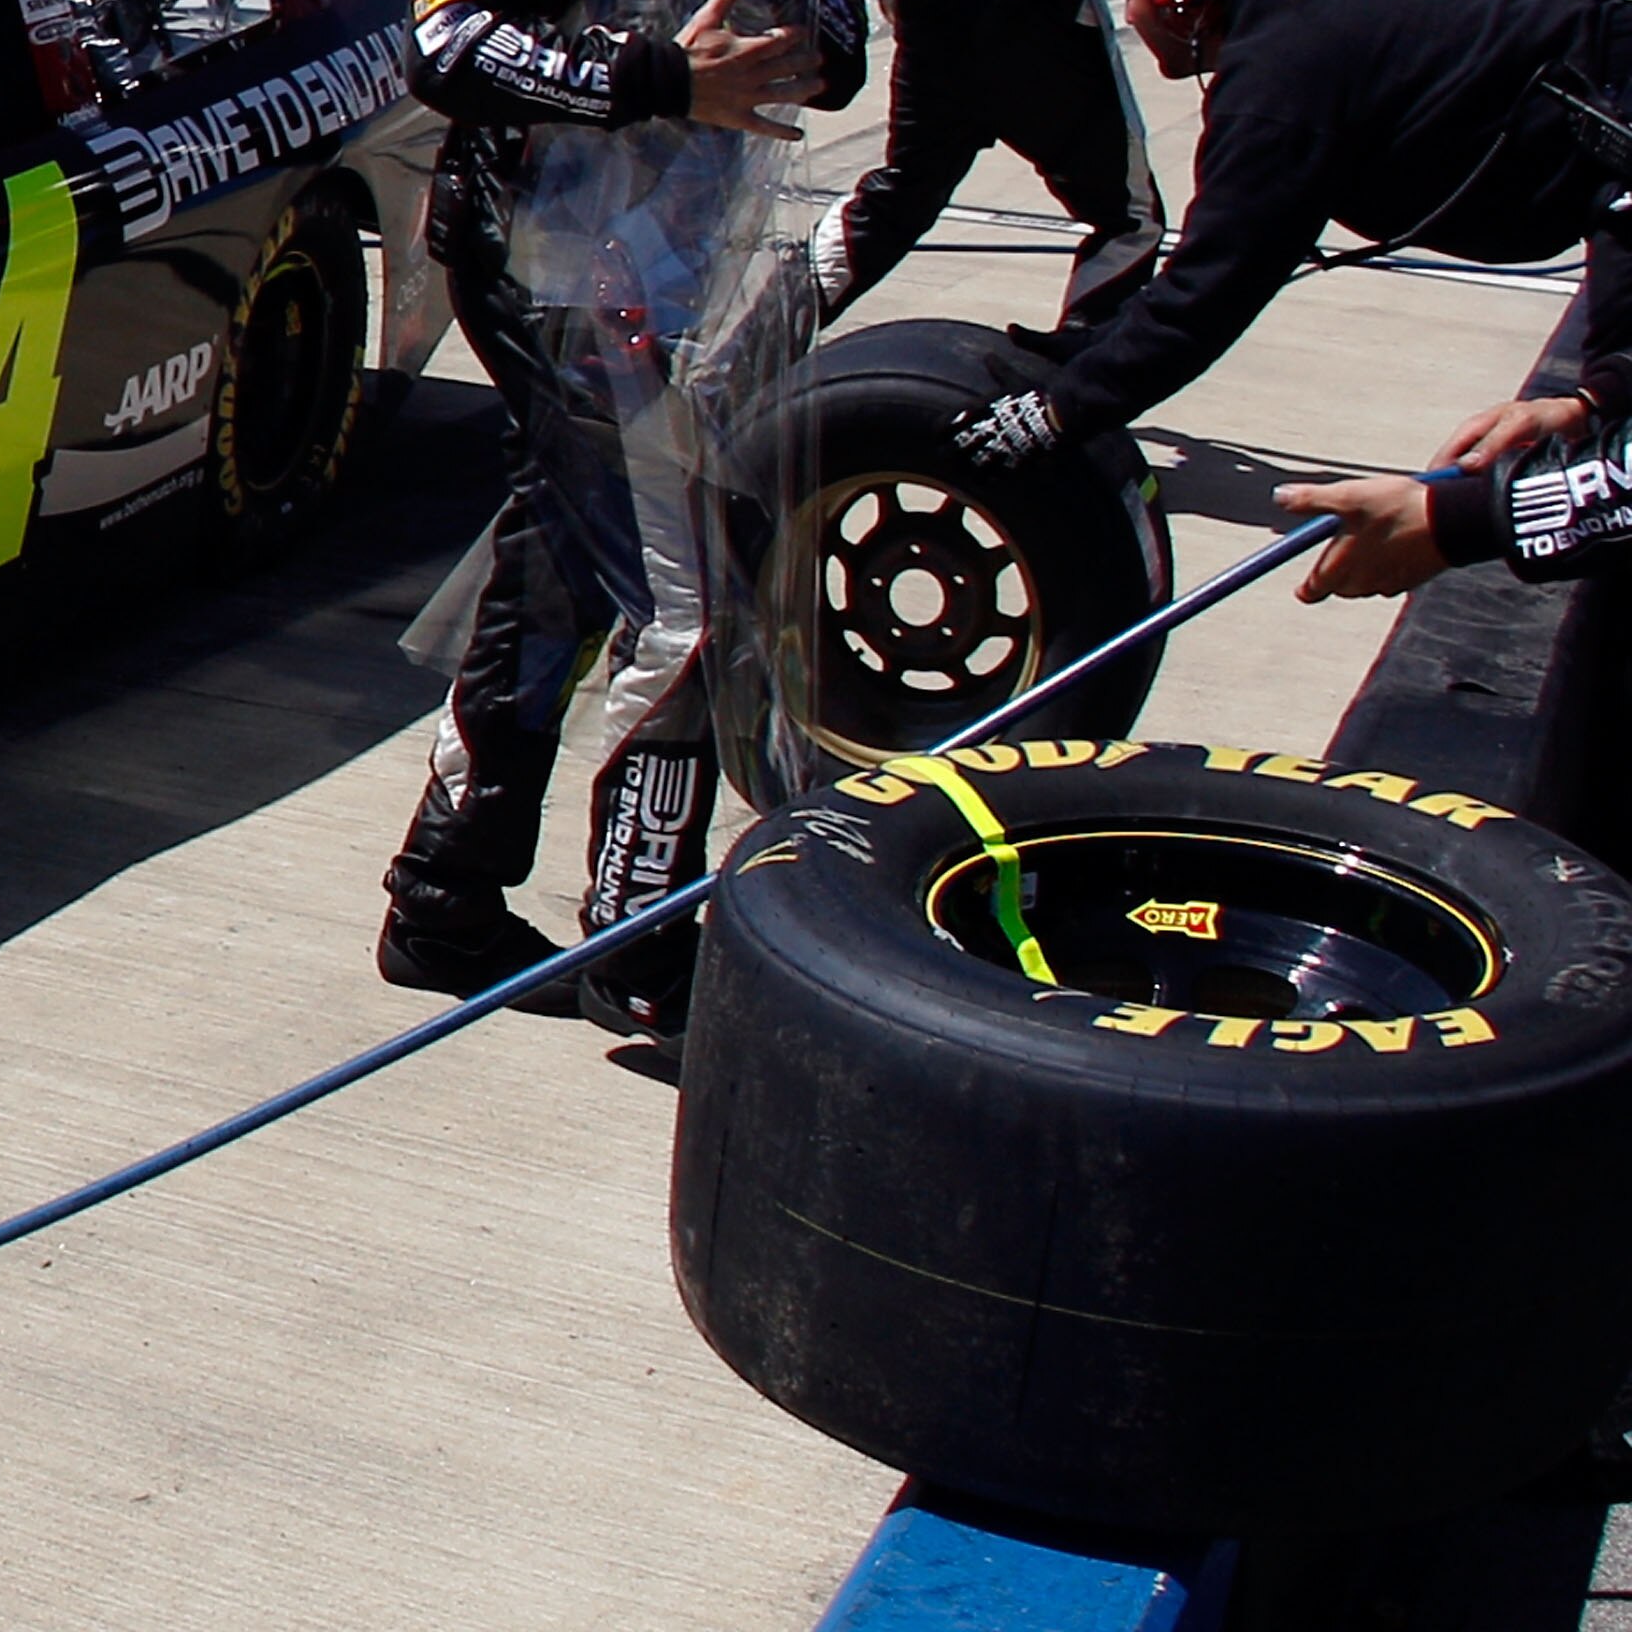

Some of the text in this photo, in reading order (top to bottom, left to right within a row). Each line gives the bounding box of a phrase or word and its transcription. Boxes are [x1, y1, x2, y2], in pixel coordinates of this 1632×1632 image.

[473, 53, 612, 111] TO END HUNGER
[478, 23, 612, 94] DRIVE
[86, 98, 261, 243] DRIVE
[237, 76, 313, 159] TO
[290, 45, 375, 137] END
[103, 341, 214, 436] AARP
[1515, 533, 1555, 559] TO
[1553, 515, 1605, 551] END
[598, 752, 647, 925] TO END HUNG
[623, 754, 699, 917] DRIV
[1144, 908, 1206, 927] AERO
[1093, 1001, 1499, 1053] EAGLE
